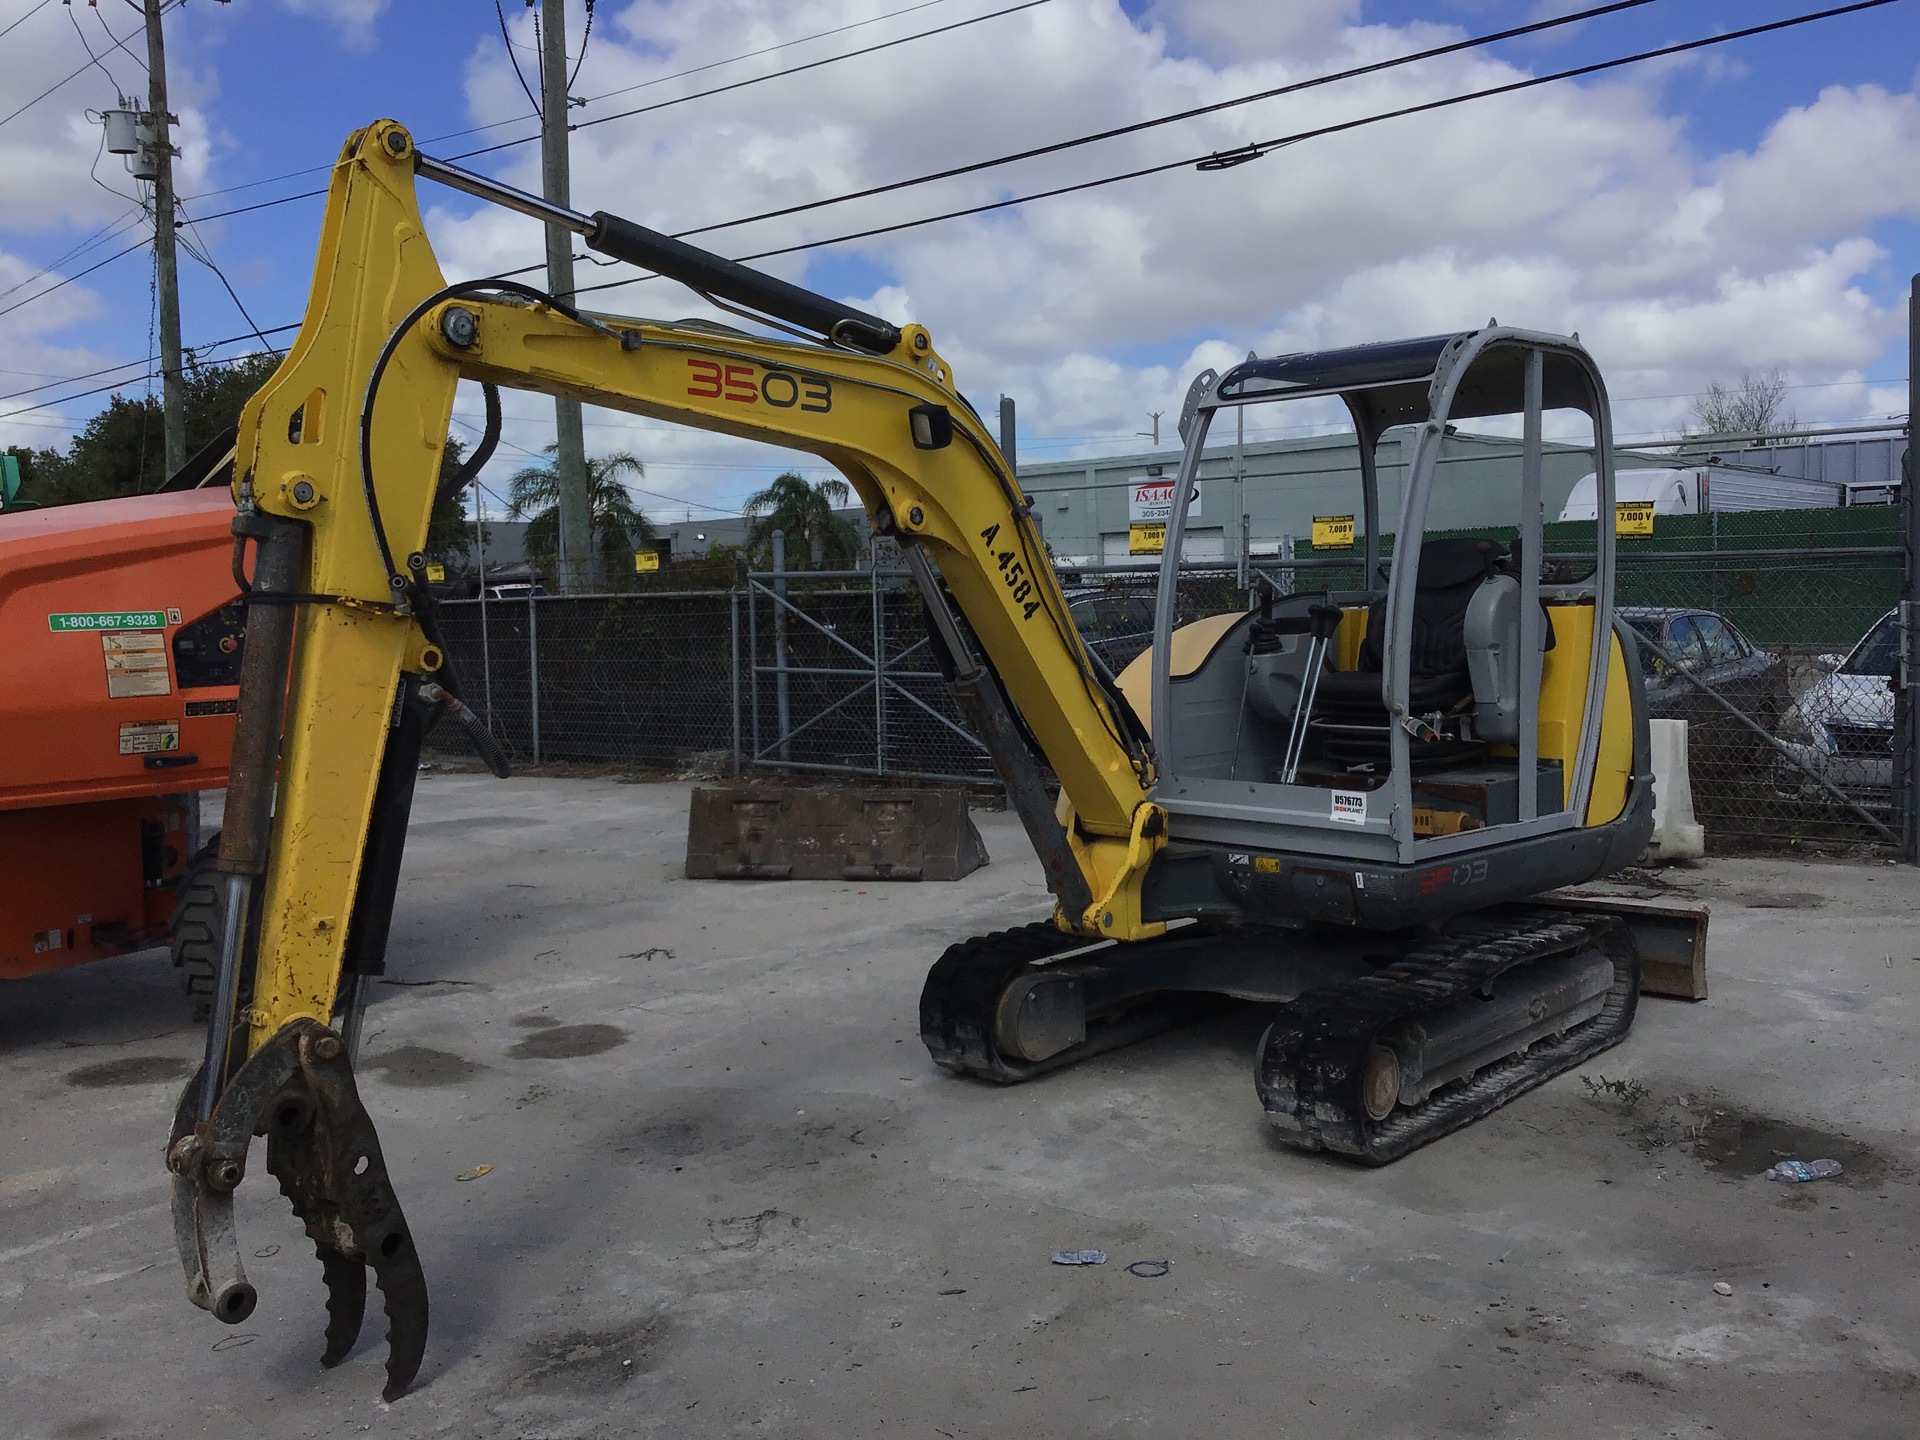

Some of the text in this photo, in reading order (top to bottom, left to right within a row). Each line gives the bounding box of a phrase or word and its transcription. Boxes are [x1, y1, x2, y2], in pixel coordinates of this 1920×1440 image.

[687, 358, 833, 414] 3503
[1142, 509, 1170, 518] 305-234
[1620, 511, 1652, 522] 7,000 V
[1328, 524, 1353, 534] 7,000 V
[1143, 531, 1159, 540] 7,000
[59, 614, 158, 628] 1-800-667-9328
[1334, 795, 1363, 807] U576773
